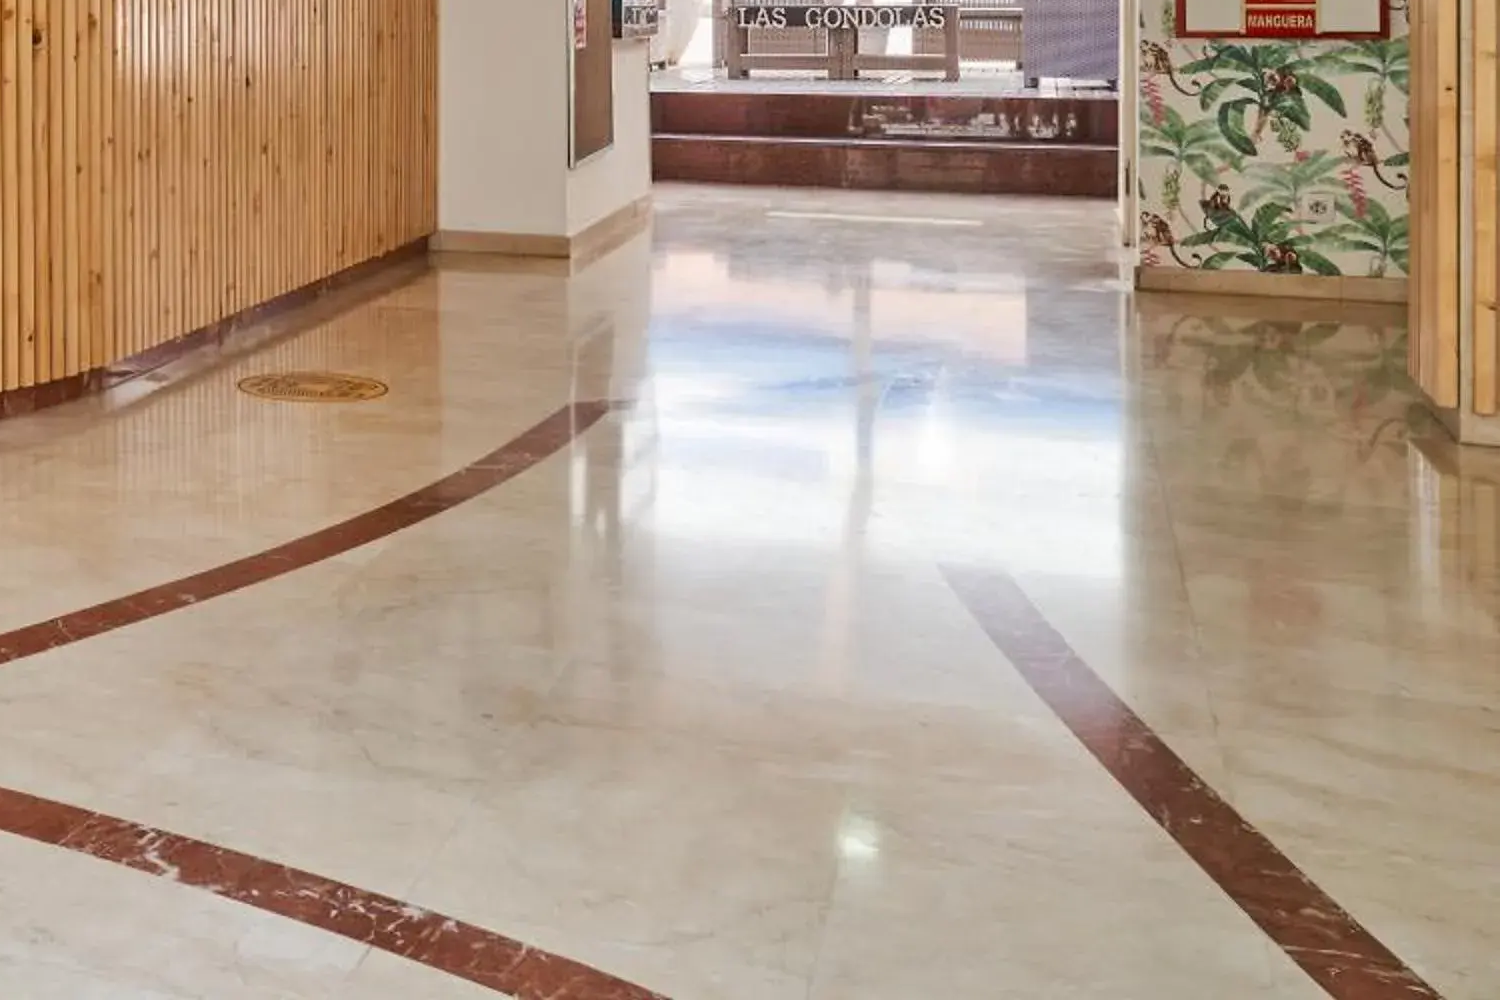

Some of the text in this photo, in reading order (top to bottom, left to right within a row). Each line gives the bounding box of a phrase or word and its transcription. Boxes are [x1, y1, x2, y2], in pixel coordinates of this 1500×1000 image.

[737, 6, 945, 29] LAS GONDOLAS
[1247, 14, 1313, 29] MANGUERA
